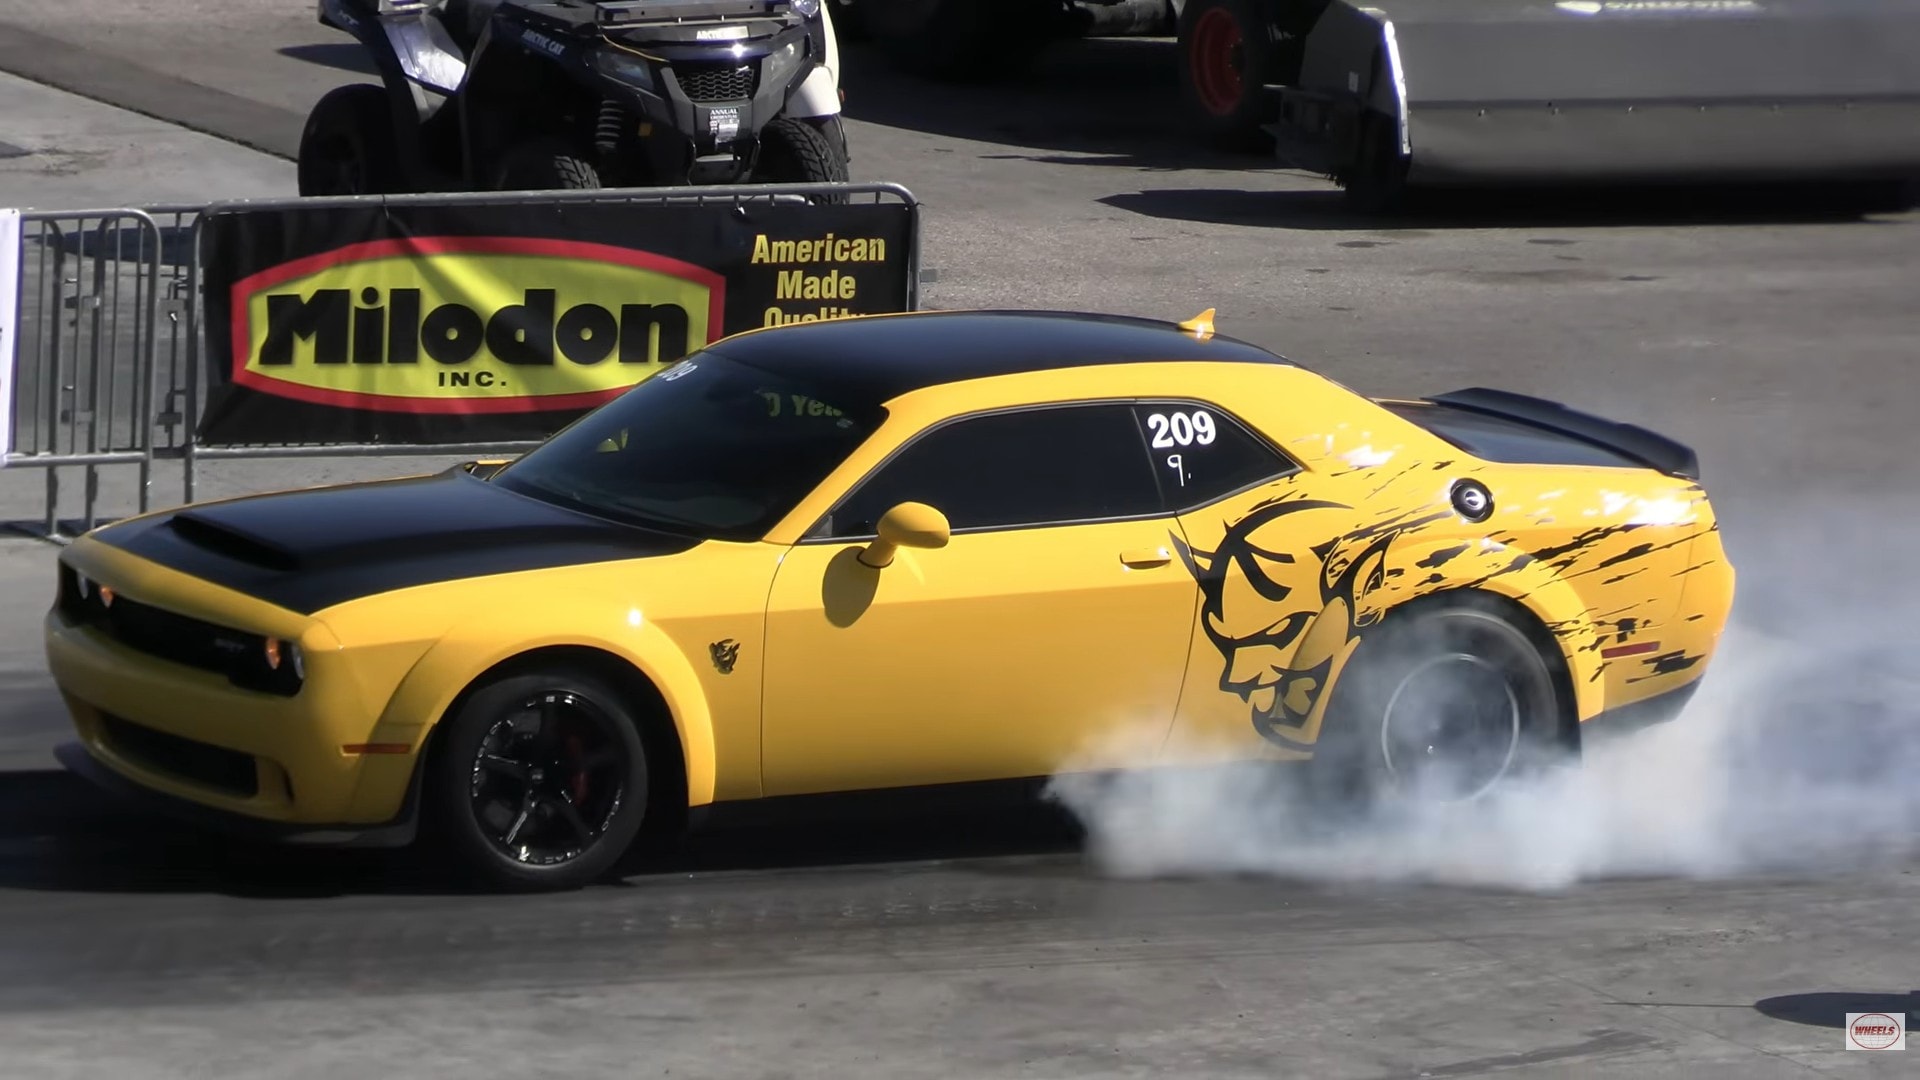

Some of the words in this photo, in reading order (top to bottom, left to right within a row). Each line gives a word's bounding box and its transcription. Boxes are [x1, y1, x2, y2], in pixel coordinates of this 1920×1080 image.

[521, 28, 548, 50] ARCTIC
[548, 39, 566, 56] CAT
[696, 28, 728, 41] ARCTI
[751, 233, 886, 264] American
[776, 269, 856, 300] Made
[258, 286, 689, 366] Milodon
[437, 372, 508, 388] INC.
[1147, 410, 1217, 449] 209
